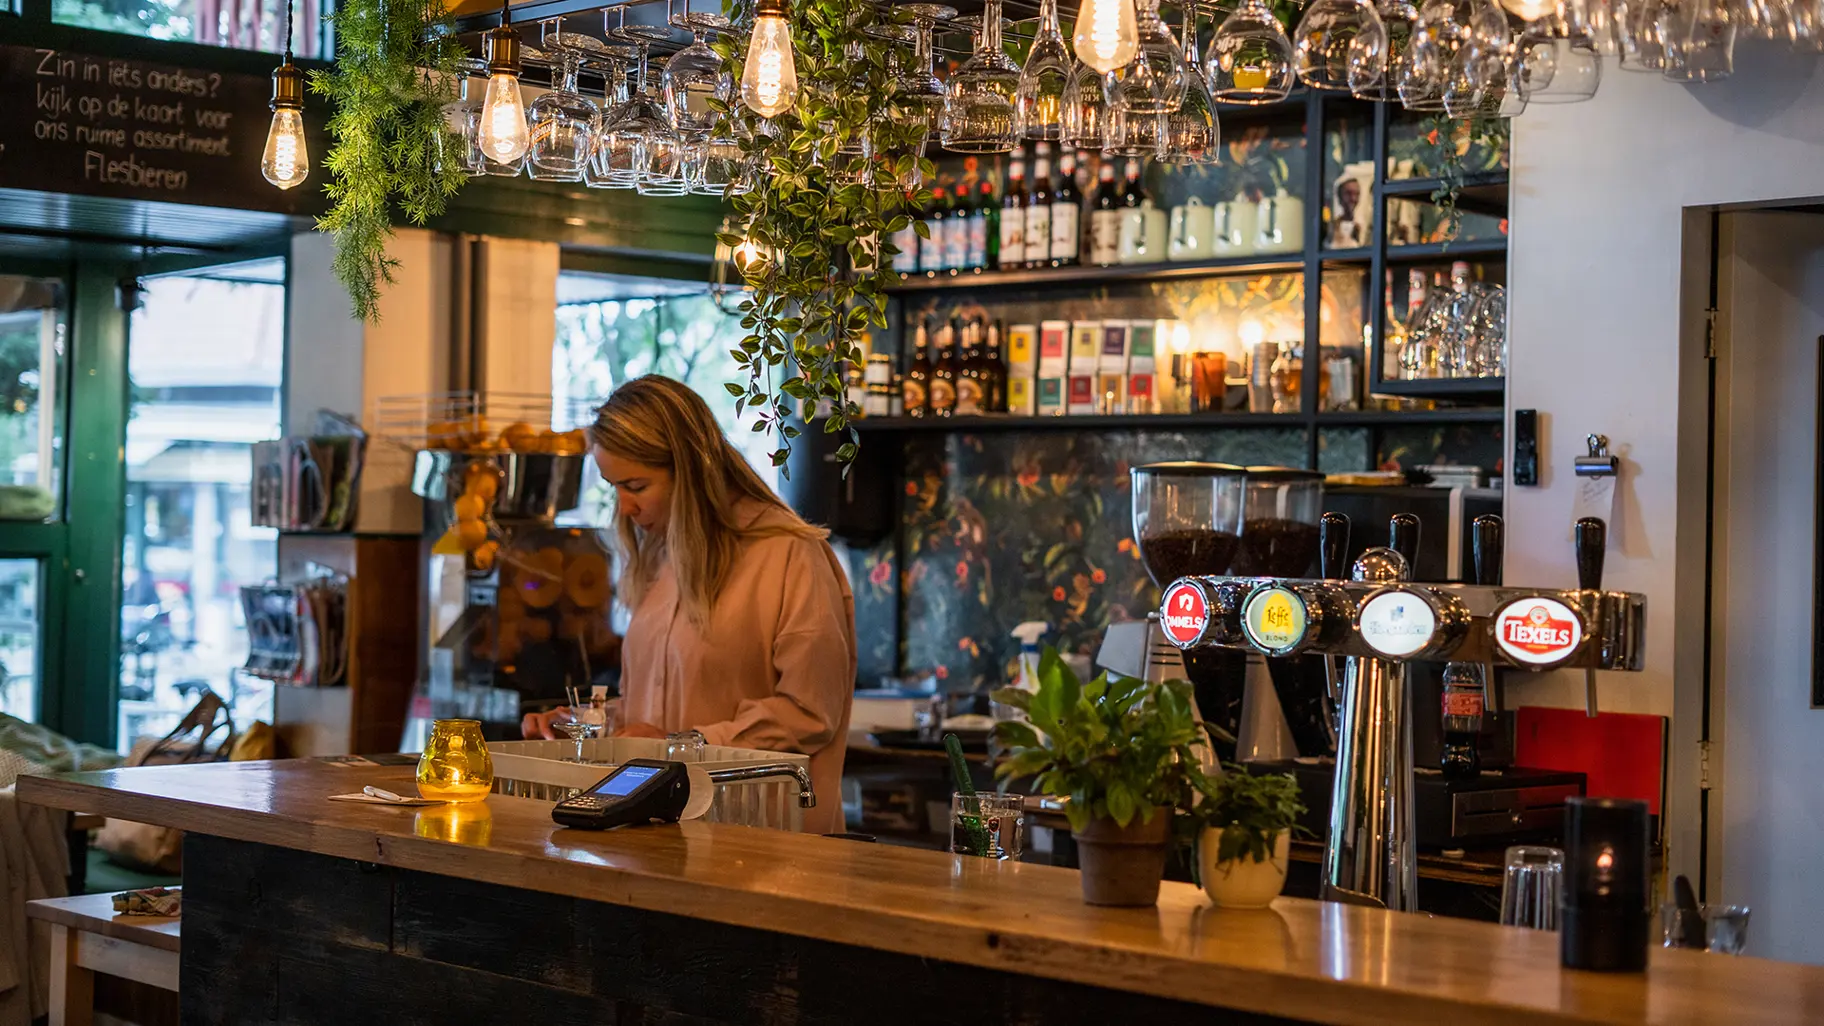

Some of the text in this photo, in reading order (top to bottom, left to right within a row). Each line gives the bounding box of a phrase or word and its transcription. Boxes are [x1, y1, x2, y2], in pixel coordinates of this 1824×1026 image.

[35, 49, 222, 98] Zin in iets anders?
[36, 82, 233, 129] kijk op de kaart voor
[34, 120, 69, 142] ons
[75, 125, 126, 148] ruime
[84, 150, 189, 190] Flesbieren
[1166, 615, 1204, 630] OMMELS
[1266, 606, 1289, 627] Leffe
[1265, 634, 1289, 642] BLOND
[1505, 620, 1570, 645] TEXELS
